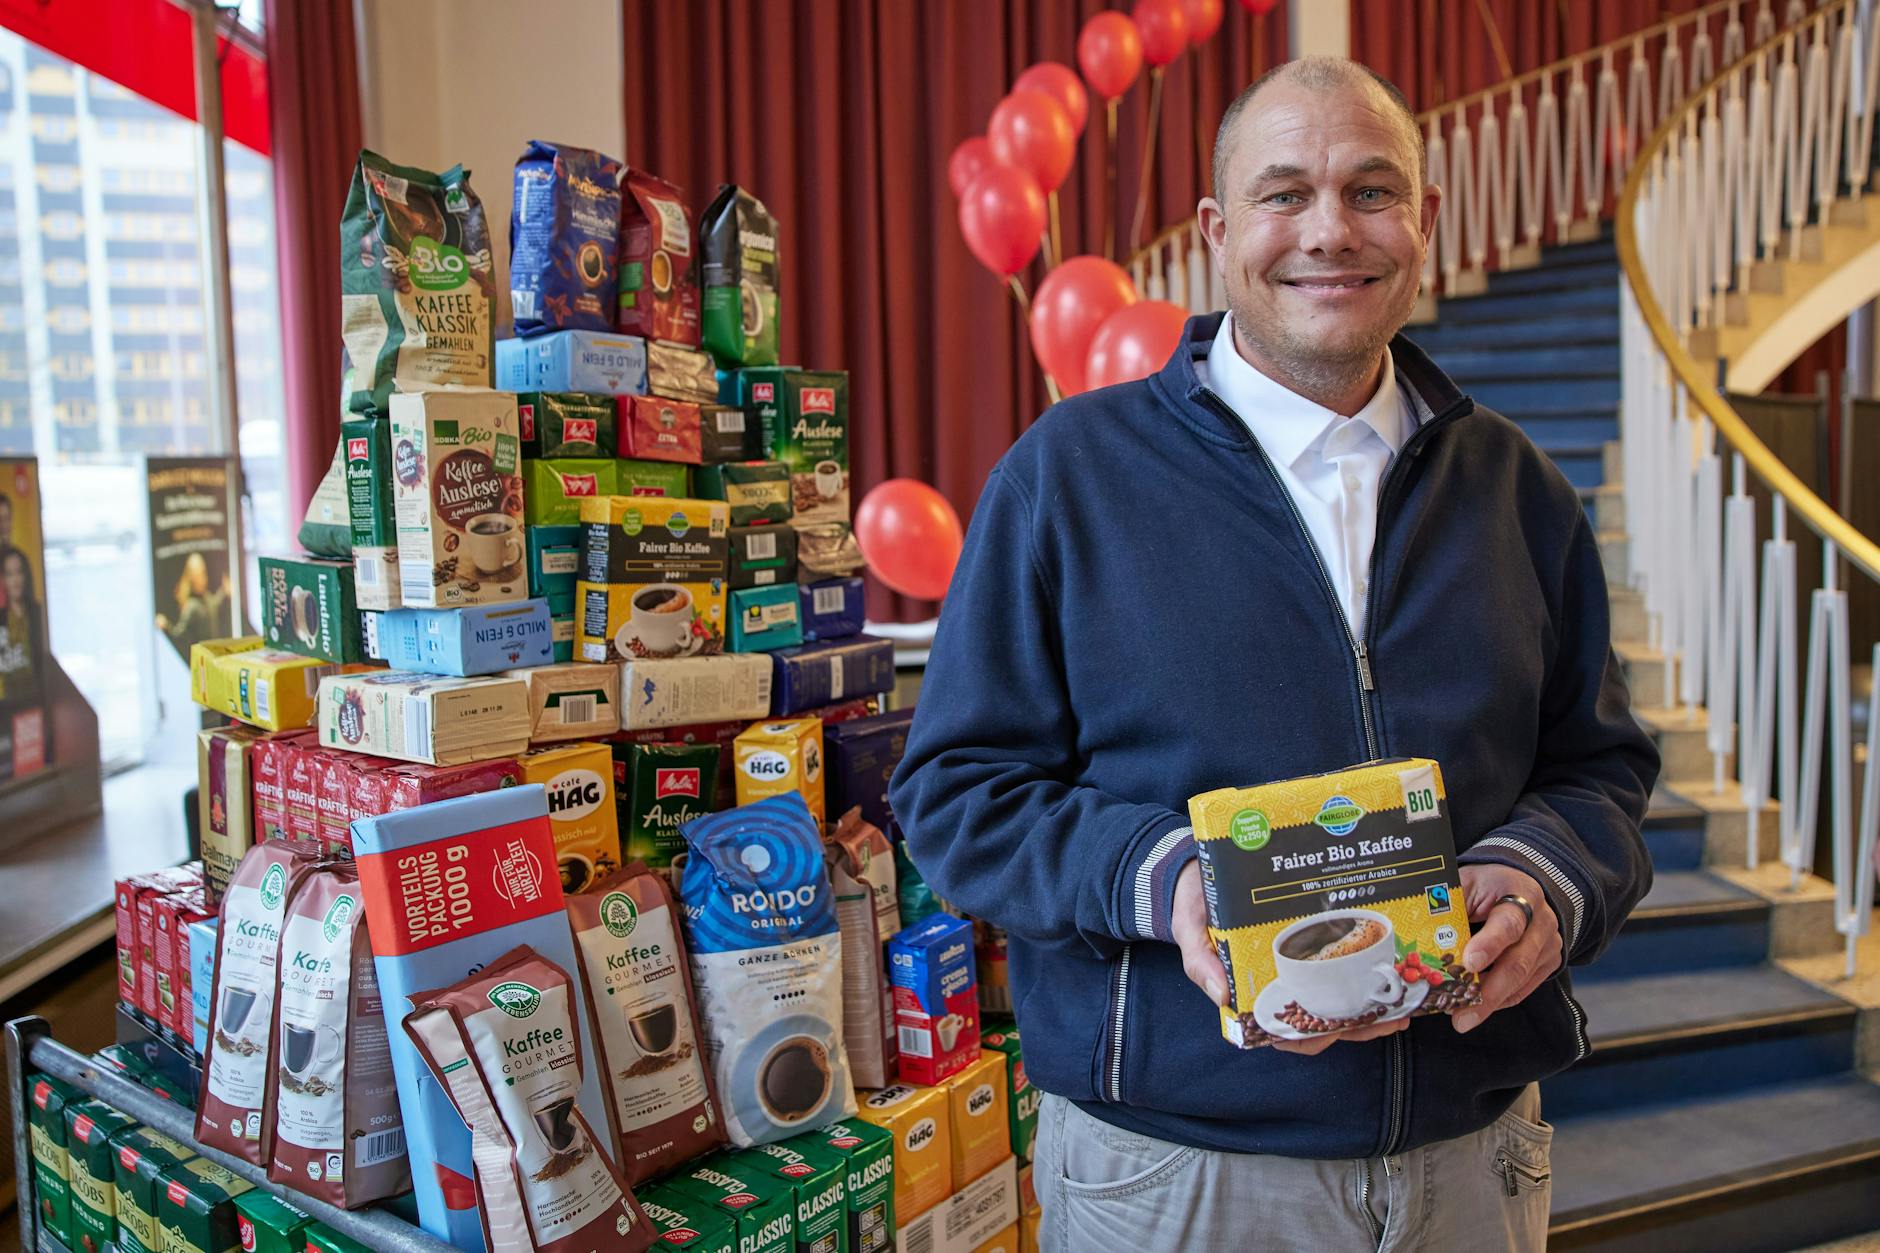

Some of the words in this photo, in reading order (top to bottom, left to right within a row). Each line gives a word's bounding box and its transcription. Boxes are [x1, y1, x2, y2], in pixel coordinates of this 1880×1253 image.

[416, 246, 464, 273] Bio
[415, 294, 473, 314] KAFFEE
[416, 314, 478, 335] KLASSIK
[426, 336, 474, 351] GEMAHLEN
[582, 352, 605, 366] FEIN
[609, 355, 616, 367] &
[617, 355, 643, 368] MILD
[461, 427, 492, 445] Bio
[792, 418, 843, 440] Auslese
[348, 463, 372, 479] Auslese
[445, 459, 486, 481] Kaffee
[439, 477, 499, 506] Auslese
[449, 501, 493, 519] aromatisch
[639, 542, 668, 553] Fairer
[670, 543, 683, 553] Bio
[684, 543, 711, 553] Kaffee
[318, 573, 332, 654] Laudatio
[476, 629, 503, 643] FEIN
[507, 626, 515, 639] &
[518, 620, 547, 637] MILD
[750, 761, 785, 774] HAG
[256, 783, 283, 798] KRÄFTIG
[561, 777, 580, 788] café
[287, 789, 315, 807] KRÄFTIG
[318, 797, 348, 816] KRÄFTIG
[548, 782, 600, 814] HAG
[1408, 788, 1434, 813] BiO
[1320, 809, 1359, 822] FAIRGLOBE
[507, 840, 527, 868] ZEIT
[1272, 850, 1324, 872] Fairer
[1327, 845, 1355, 862] Bio
[1358, 836, 1413, 856] Kaffee
[502, 859, 515, 879] FÜR
[1321, 862, 1356, 873] vollmundiges
[1357, 859, 1374, 867] Aroma
[507, 880, 522, 898] NUR
[517, 866, 538, 902] KURZE
[1302, 880, 1321, 891] 100%
[1322, 873, 1367, 888] zertifizierter
[1368, 869, 1397, 881] Arabica
[398, 855, 429, 943] VORTEILS
[419, 851, 450, 937] PACKUNG
[445, 868, 474, 929] 1000
[731, 885, 817, 914] ROIDO
[751, 916, 804, 929] ORIGINAL
[606, 944, 661, 971] Kaffee
[738, 954, 779, 966] GANZE
[783, 945, 821, 959] BOHNEN
[605, 954, 673, 984] GOURMET
[501, 994, 540, 1017] LEBENSBAUM
[503, 1027, 563, 1057] Kaffee
[502, 1041, 575, 1073] GOURMET
[516, 1066, 548, 1083] Gemahlen
[970, 1090, 991, 1114] HAG
[909, 1122, 934, 1149] HAG
[33, 1135, 61, 1169] JACOBS
[636, 1152, 647, 1160] BIO
[648, 1147, 661, 1157] SEIT
[691, 1168, 748, 1194] CLASSIC
[848, 1155, 892, 1192] CLASSIC
[71, 1170, 106, 1206] JACOBS
[798, 1182, 844, 1223] CLASSIC
[72, 1202, 105, 1232] KRÖNUNG
[118, 1199, 150, 1240] JACOBS
[740, 1213, 792, 1253] CLASSIC
